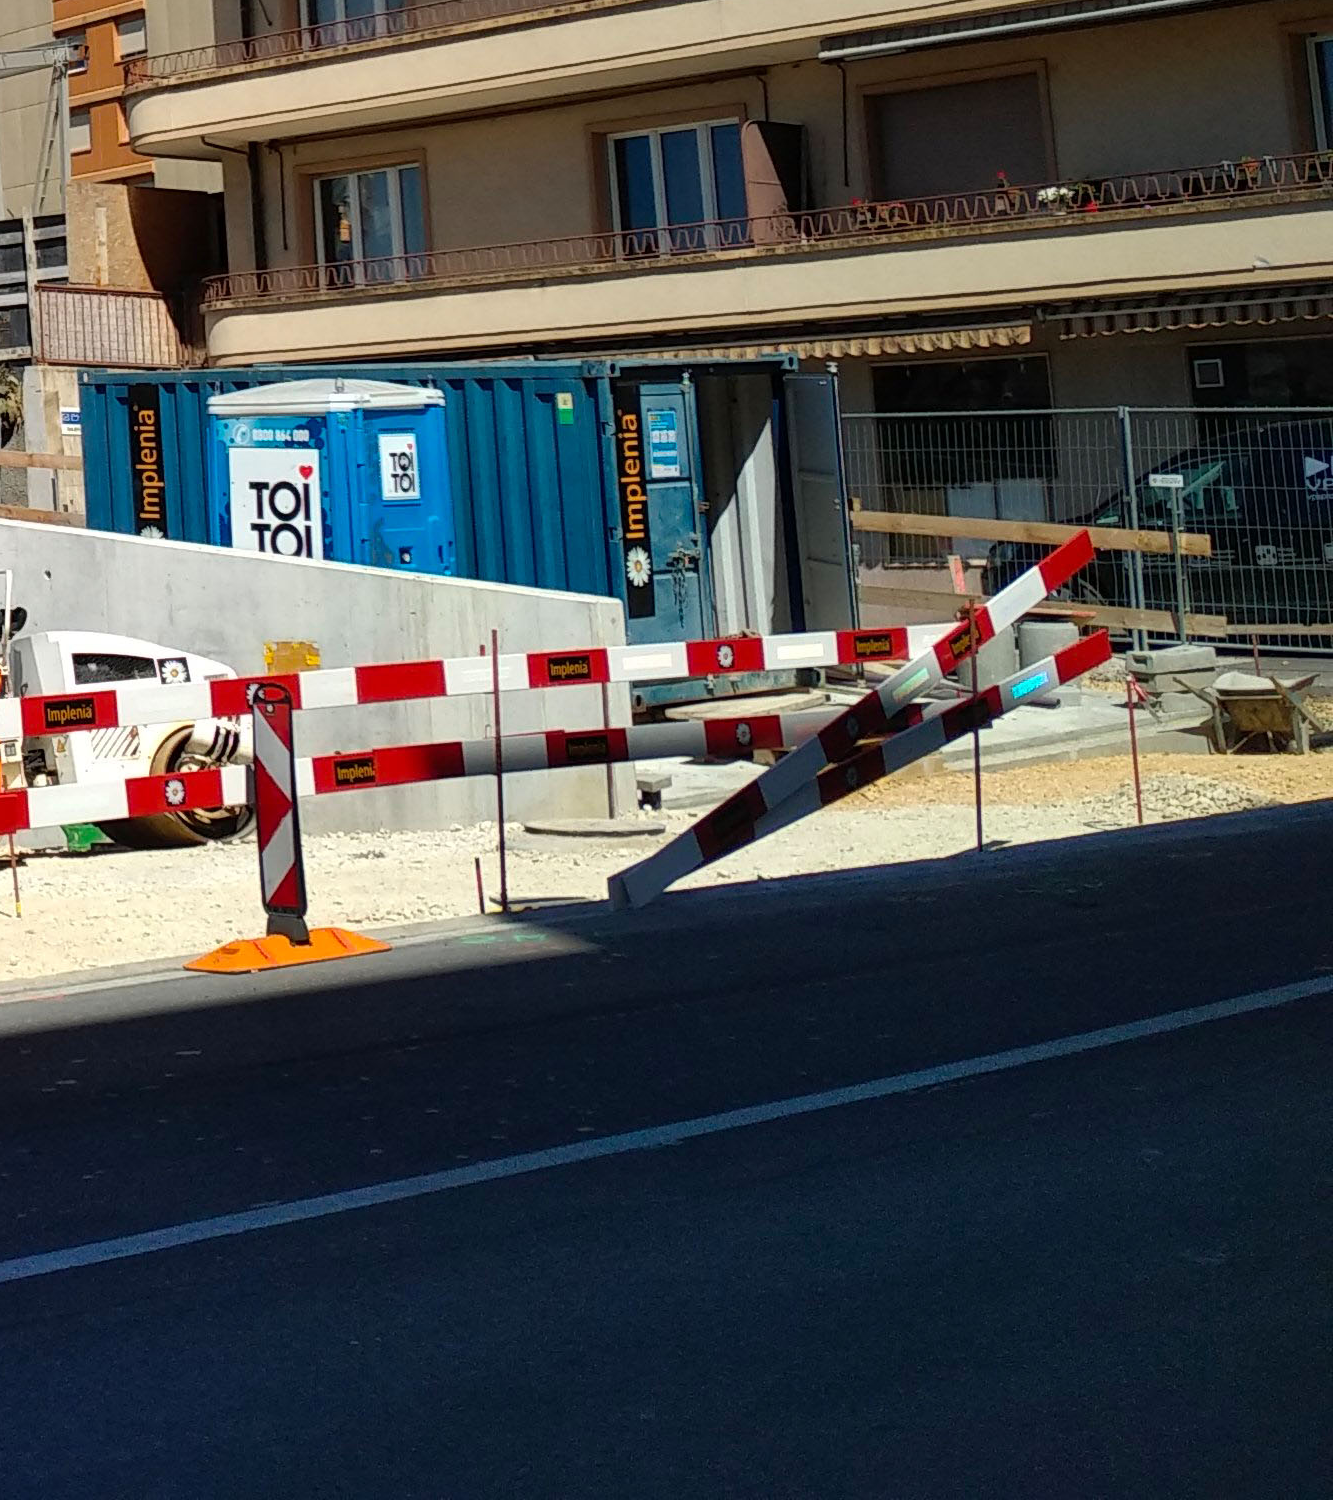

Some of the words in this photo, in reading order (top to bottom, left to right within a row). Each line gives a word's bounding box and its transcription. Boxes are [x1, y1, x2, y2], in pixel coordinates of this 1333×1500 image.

[135, 409, 165, 519] Implenia
[389, 452, 414, 472] TOI
[391, 473, 416, 493] TOI
[618, 413, 648, 539] Implenia
[249, 481, 312, 521] TOI
[250, 523, 313, 558] TOI
[550, 660, 589, 679] Implenia
[48, 705, 93, 725] Implenia
